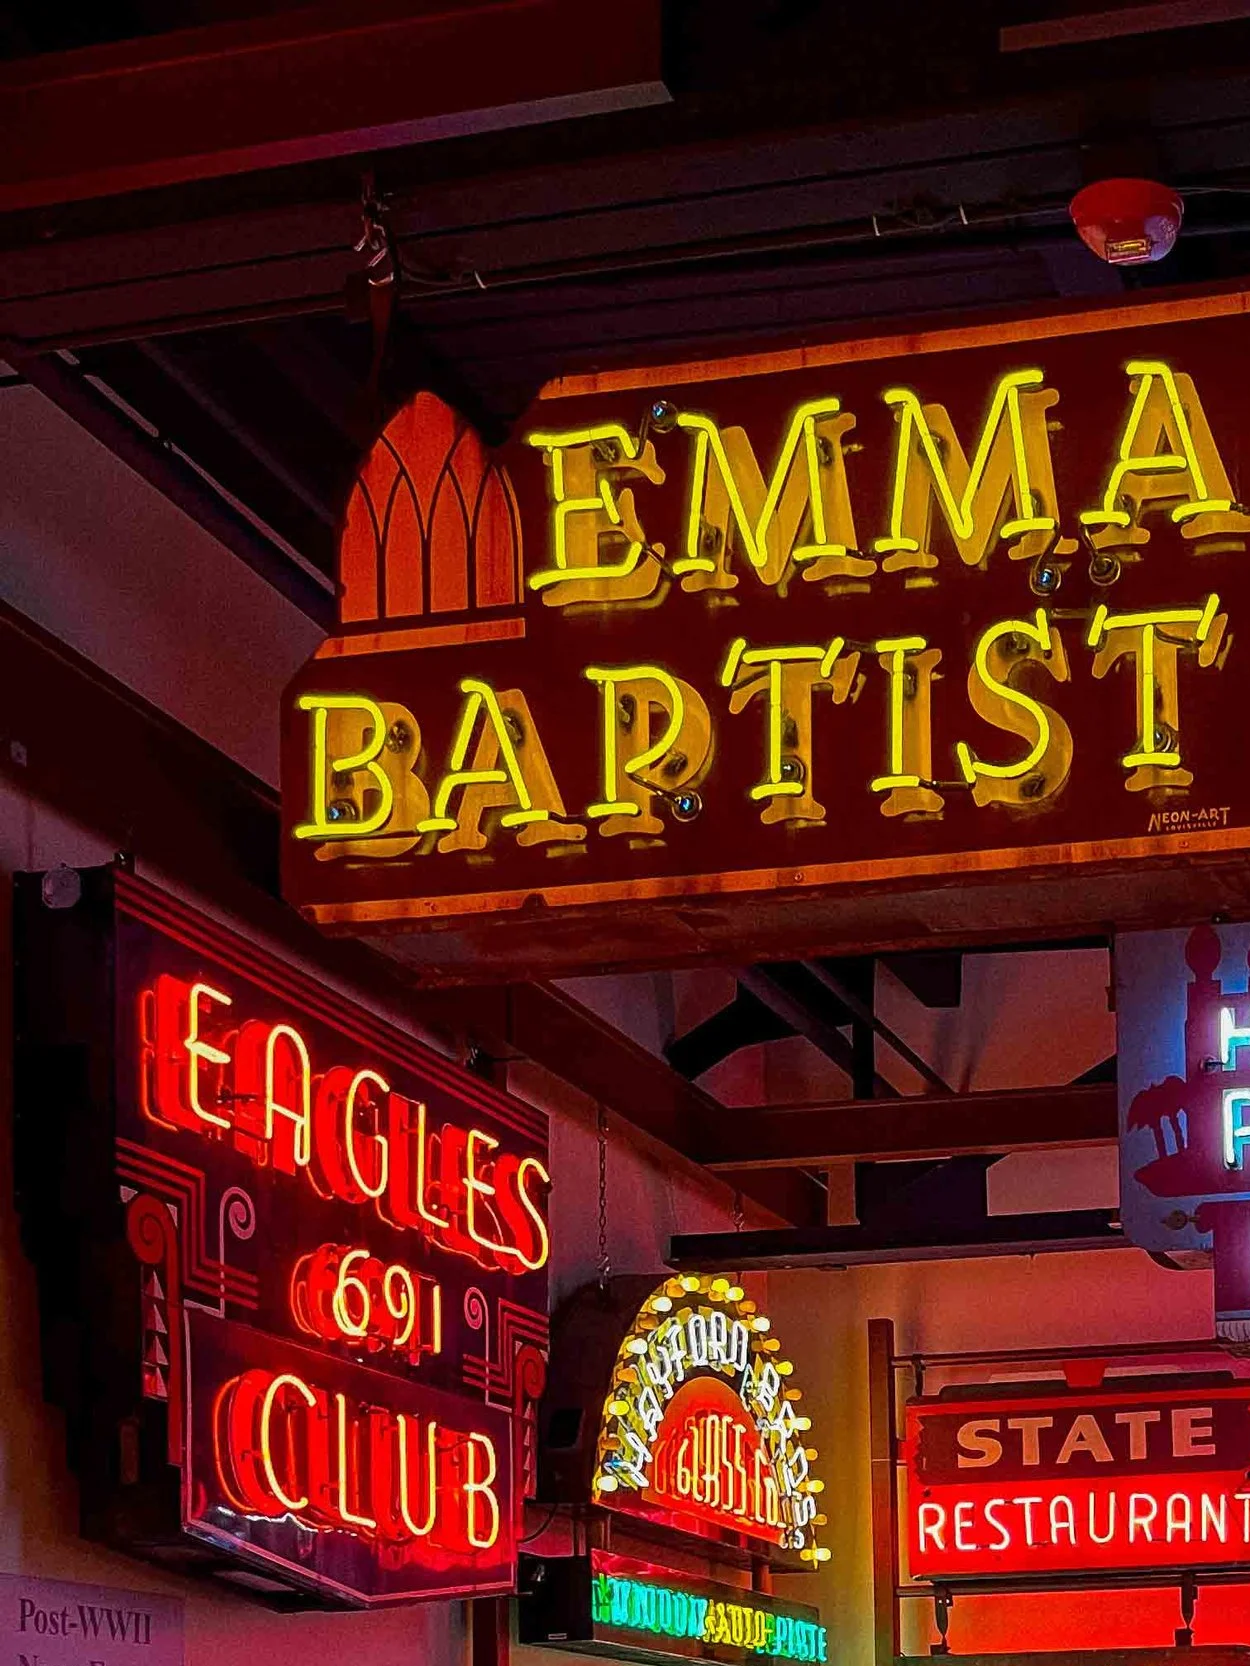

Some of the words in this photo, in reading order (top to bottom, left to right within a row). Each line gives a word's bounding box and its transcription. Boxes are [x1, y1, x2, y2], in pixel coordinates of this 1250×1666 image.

[297, 595, 1228, 852] BAPTIST
[1148, 807, 1230, 832] NEON-ART
[146, 976, 550, 1272] EAGLES
[308, 1246, 442, 1357] 691
[238, 1372, 501, 1549] CLUB
[957, 1408, 1217, 1469] STATE
[18, 1598, 152, 1645] Post-WWII
